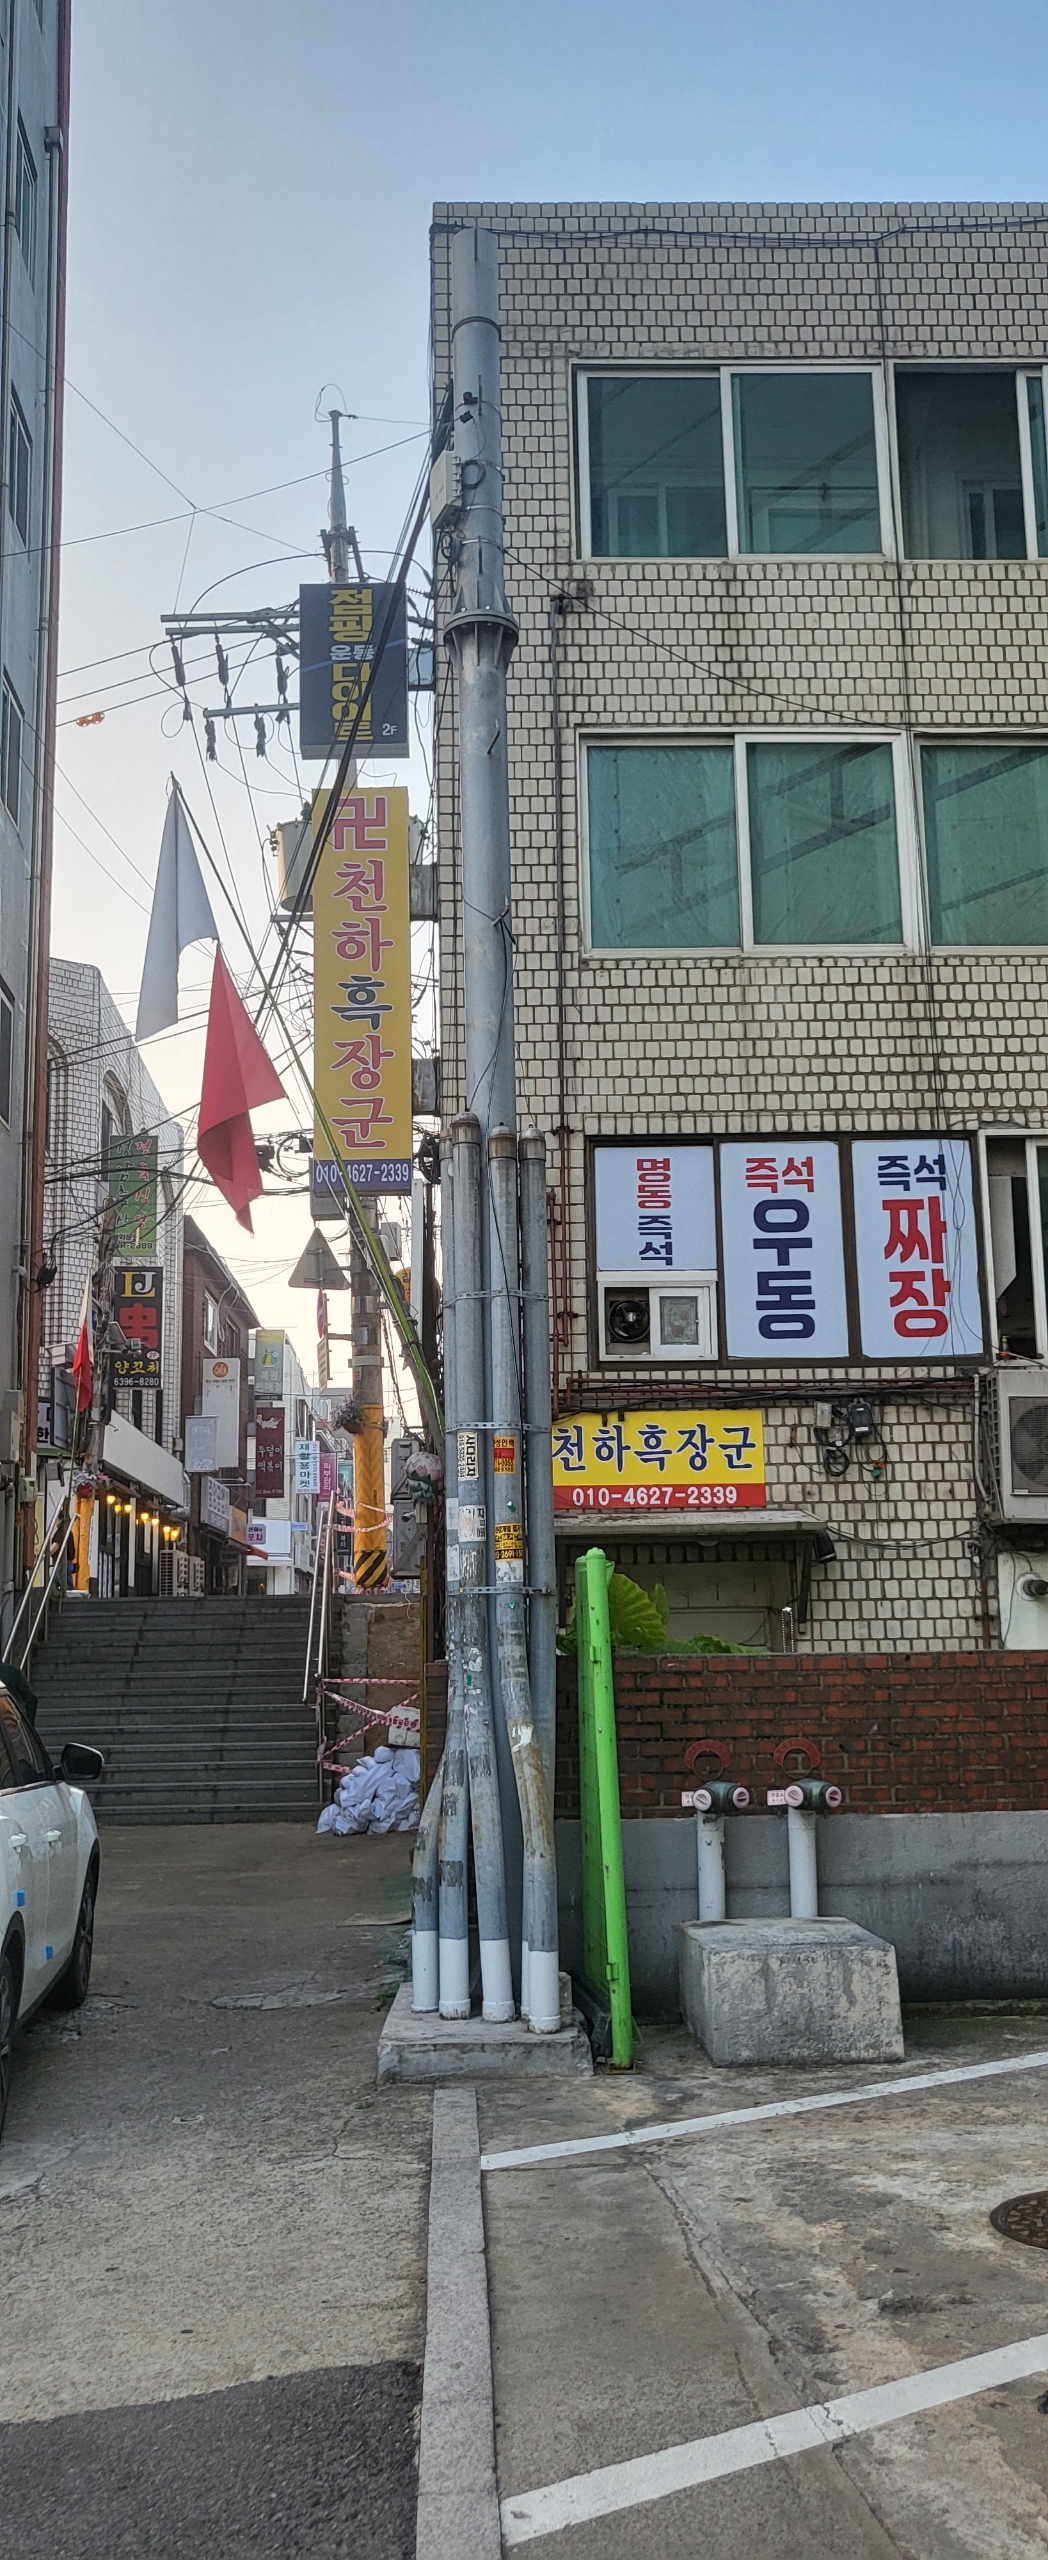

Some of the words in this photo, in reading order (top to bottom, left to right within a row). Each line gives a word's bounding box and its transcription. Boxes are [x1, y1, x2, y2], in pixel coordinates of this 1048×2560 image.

[329, 588, 373, 642] 점핑
[329, 644, 375, 661] 운동
[382, 723, 398, 736] 2F
[331, 859, 395, 1149] 천하흑장군
[315, 1163, 409, 1182] 010-4627-2339
[637, 1158, 672, 1210] 명동
[745, 1156, 815, 1193] 즉석
[877, 1154, 947, 1191] 즉석
[638, 1215, 673, 1266] 즉석
[753, 1199, 816, 1339] 우동
[882, 1196, 951, 1338] 짜장
[115, 1361, 159, 1375] 양꼬치
[149, 1351, 158, 1359] 2F
[113, 1377, 160, 1386] 6396-8280
[257, 1460, 283, 1474] 떡볶이
[299, 1442, 311, 1489] 재활용마켓
[552, 1424, 757, 1473] 천하흑장군
[323, 1462, 331, 1491] 피부관리
[572, 1486, 738, 1506] 010-4627-2339
